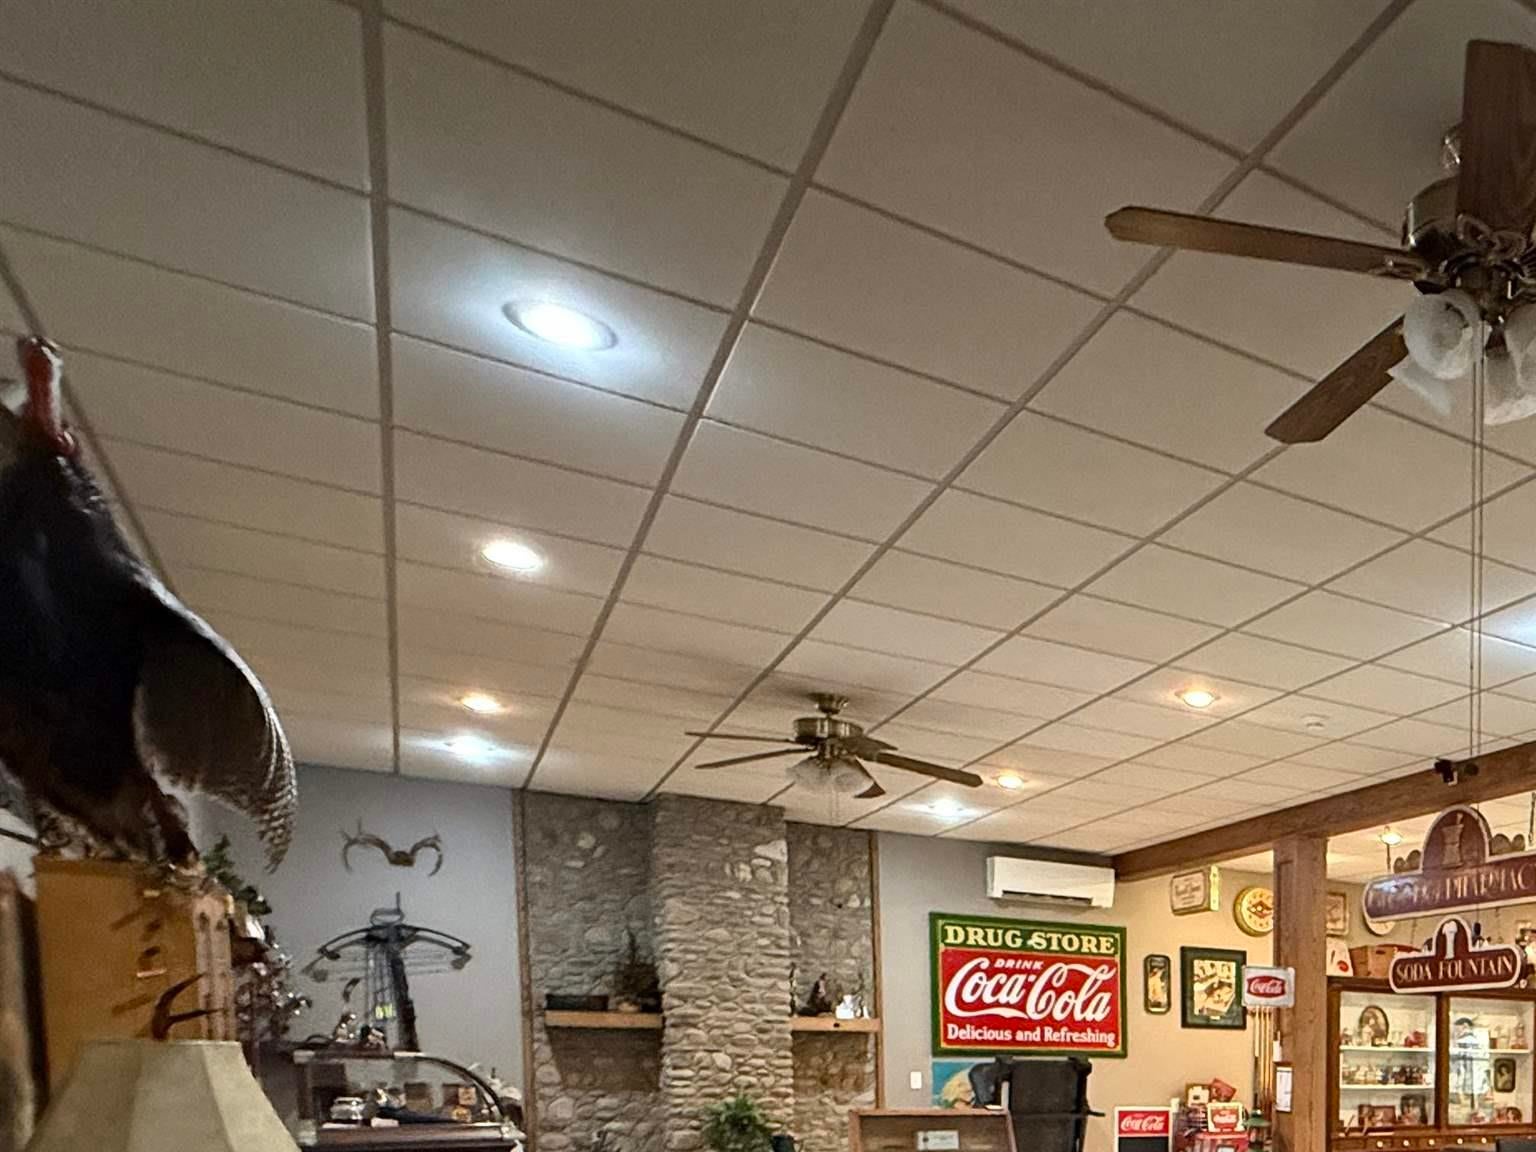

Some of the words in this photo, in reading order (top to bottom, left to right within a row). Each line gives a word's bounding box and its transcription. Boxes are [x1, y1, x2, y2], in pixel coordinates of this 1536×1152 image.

[944, 925, 1023, 948] DRUG
[1027, 931, 1115, 954] STORE
[994, 958, 1043, 970] DRINK
[1396, 963, 1432, 982] SODA
[1439, 955, 1513, 979] FOUNTAIN
[945, 957, 1117, 1022] Coca-Cola
[947, 1023, 1012, 1041] Delicious
[1016, 1026, 1041, 1041] and
[1044, 1028, 1116, 1048] Refreshing
